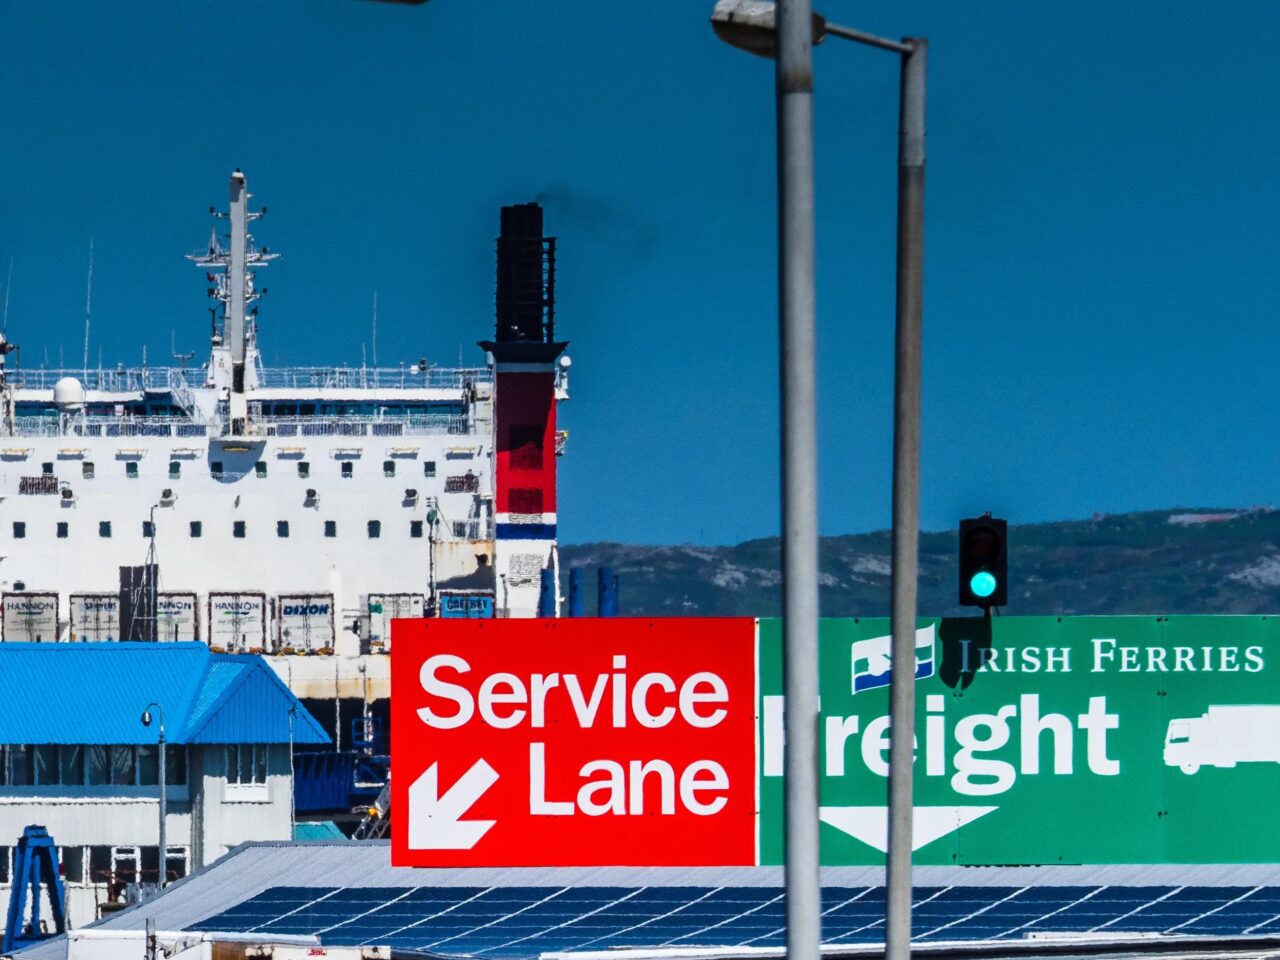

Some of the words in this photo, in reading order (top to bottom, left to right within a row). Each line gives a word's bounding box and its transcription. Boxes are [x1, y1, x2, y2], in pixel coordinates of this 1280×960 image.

[6, 601, 55, 611] HANNON
[157, 601, 192, 611] NNON
[214, 602, 260, 611] HANNON
[283, 604, 329, 616] DIXON
[957, 638, 1073, 674] IRISH
[1090, 637, 1266, 674] FERRIES
[416, 653, 730, 730] Service
[529, 741, 730, 817] Lane
